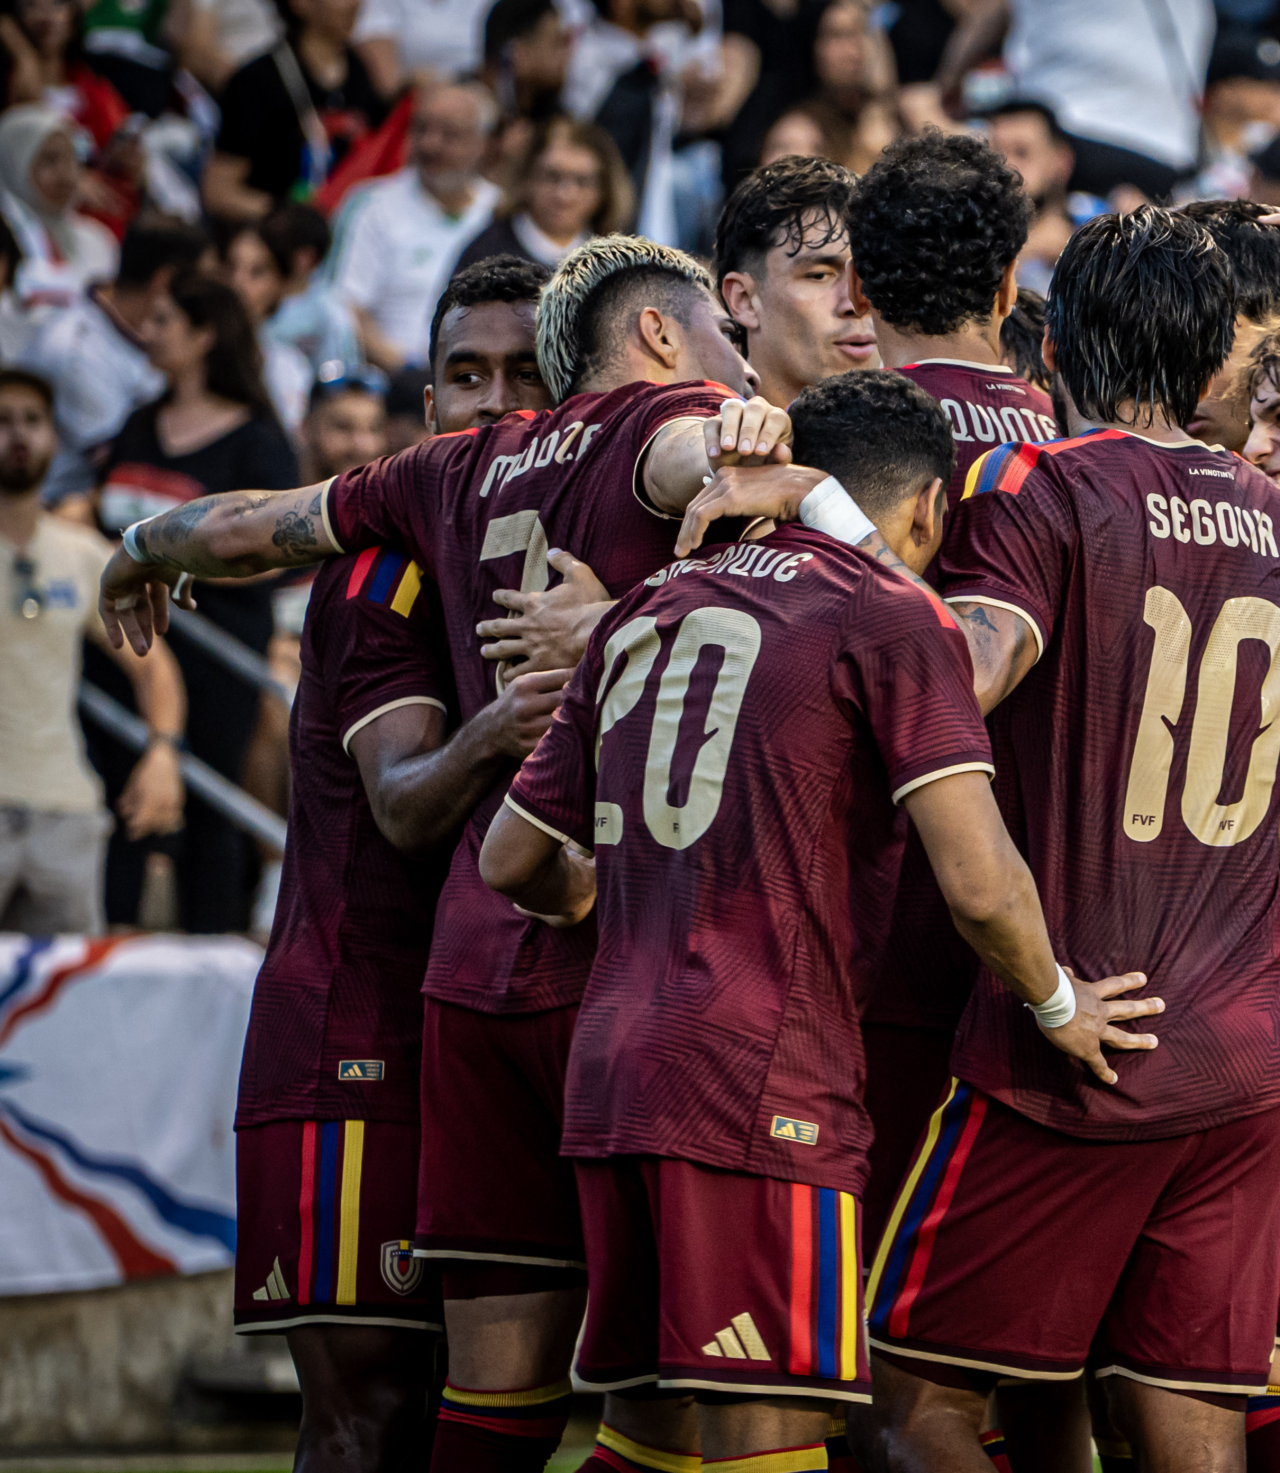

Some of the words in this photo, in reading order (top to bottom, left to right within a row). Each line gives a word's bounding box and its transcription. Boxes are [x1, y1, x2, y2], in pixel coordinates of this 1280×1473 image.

[940, 398, 1057, 444] QUINTE
[1188, 468, 1200, 476] LA
[595, 606, 763, 850] 20
[595, 816, 608, 828] VF
[1131, 813, 1156, 826] FVF
